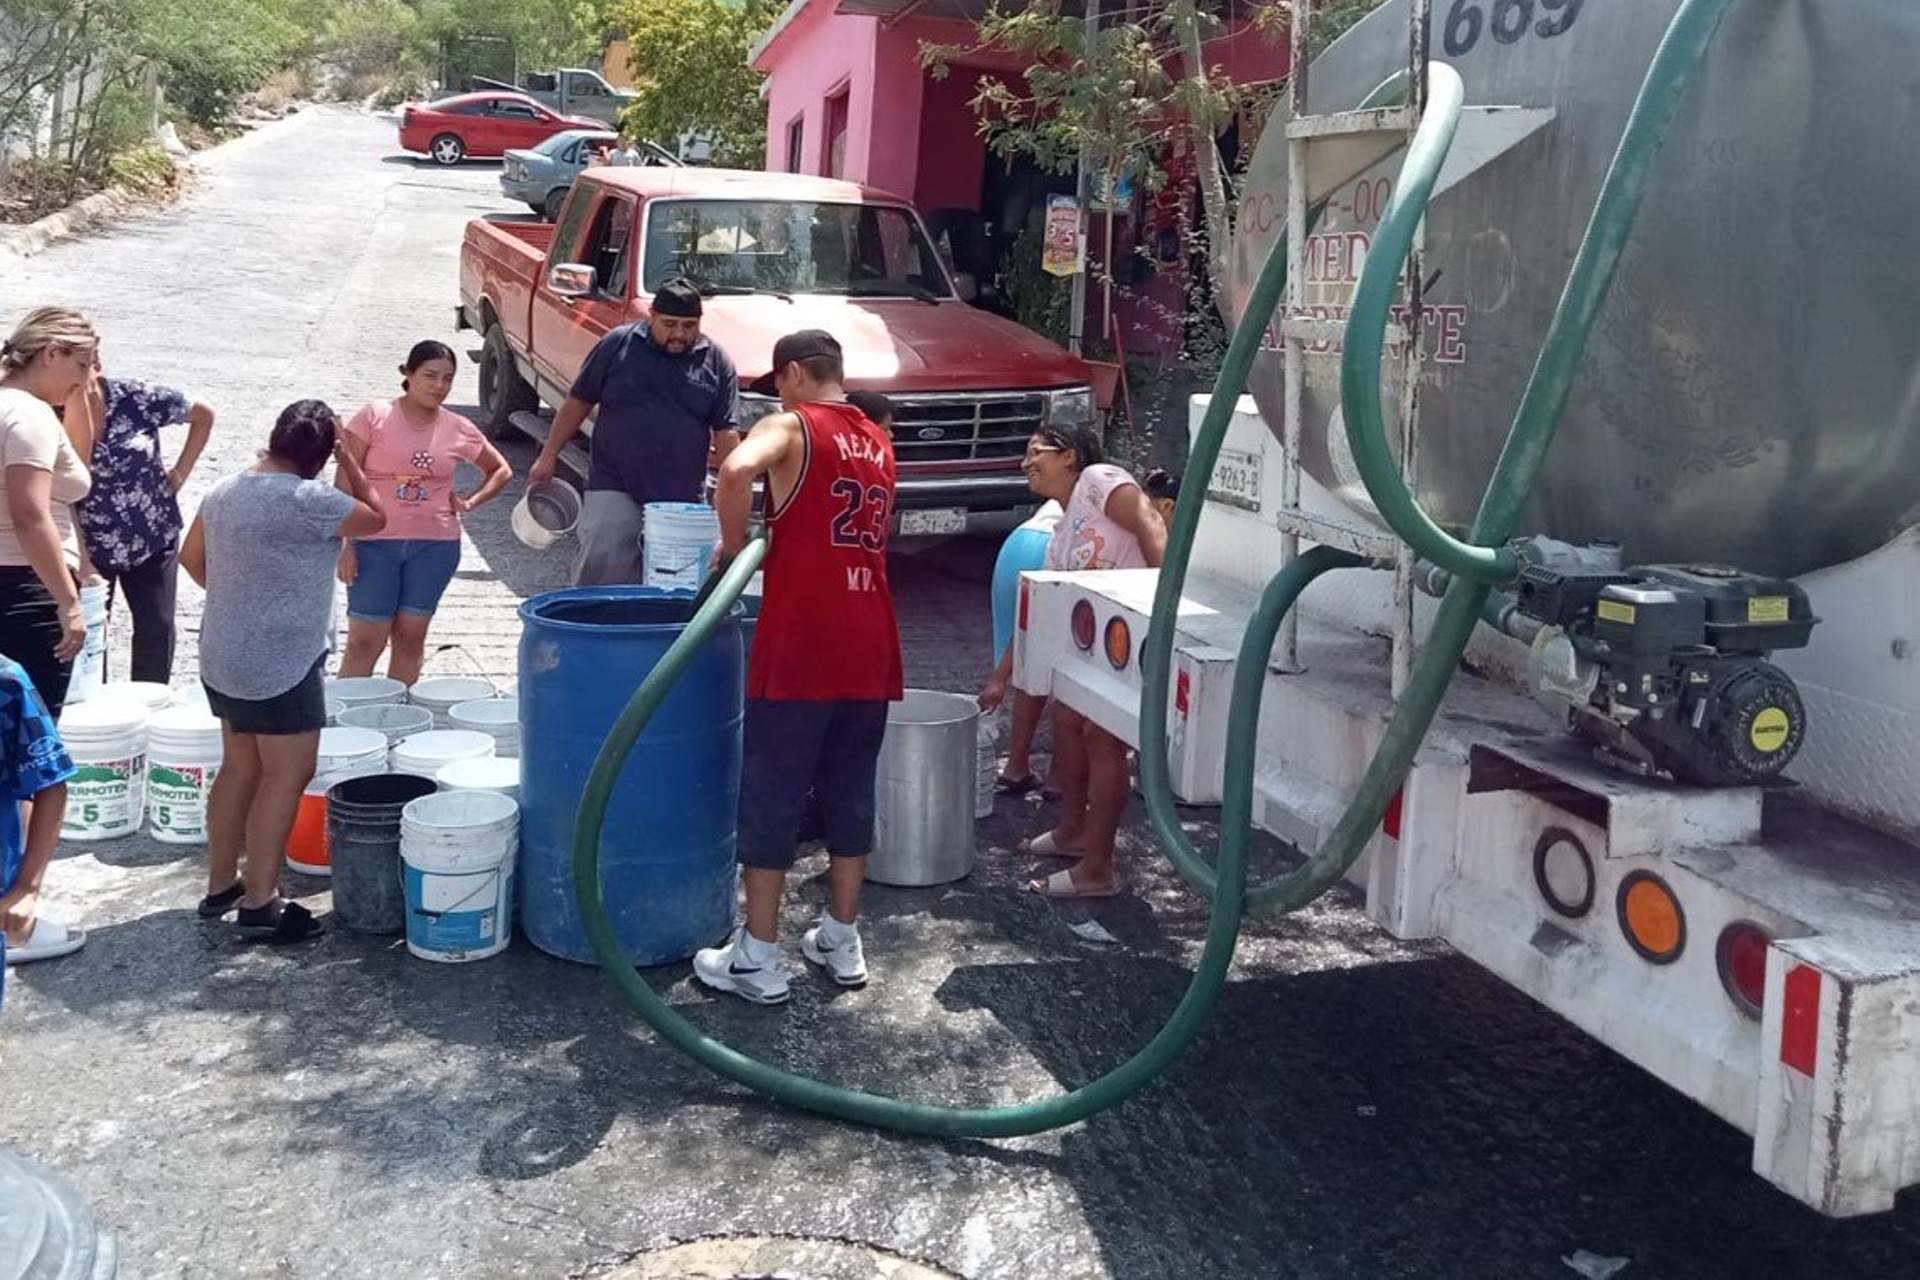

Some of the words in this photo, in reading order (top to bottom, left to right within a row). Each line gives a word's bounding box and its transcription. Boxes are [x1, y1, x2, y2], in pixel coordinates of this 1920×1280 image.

[832, 432, 886, 469] MEXA
[830, 477, 890, 553] 23
[846, 565, 877, 592] MV
[84, 803, 99, 823] 5
[159, 806, 171, 826] 5
